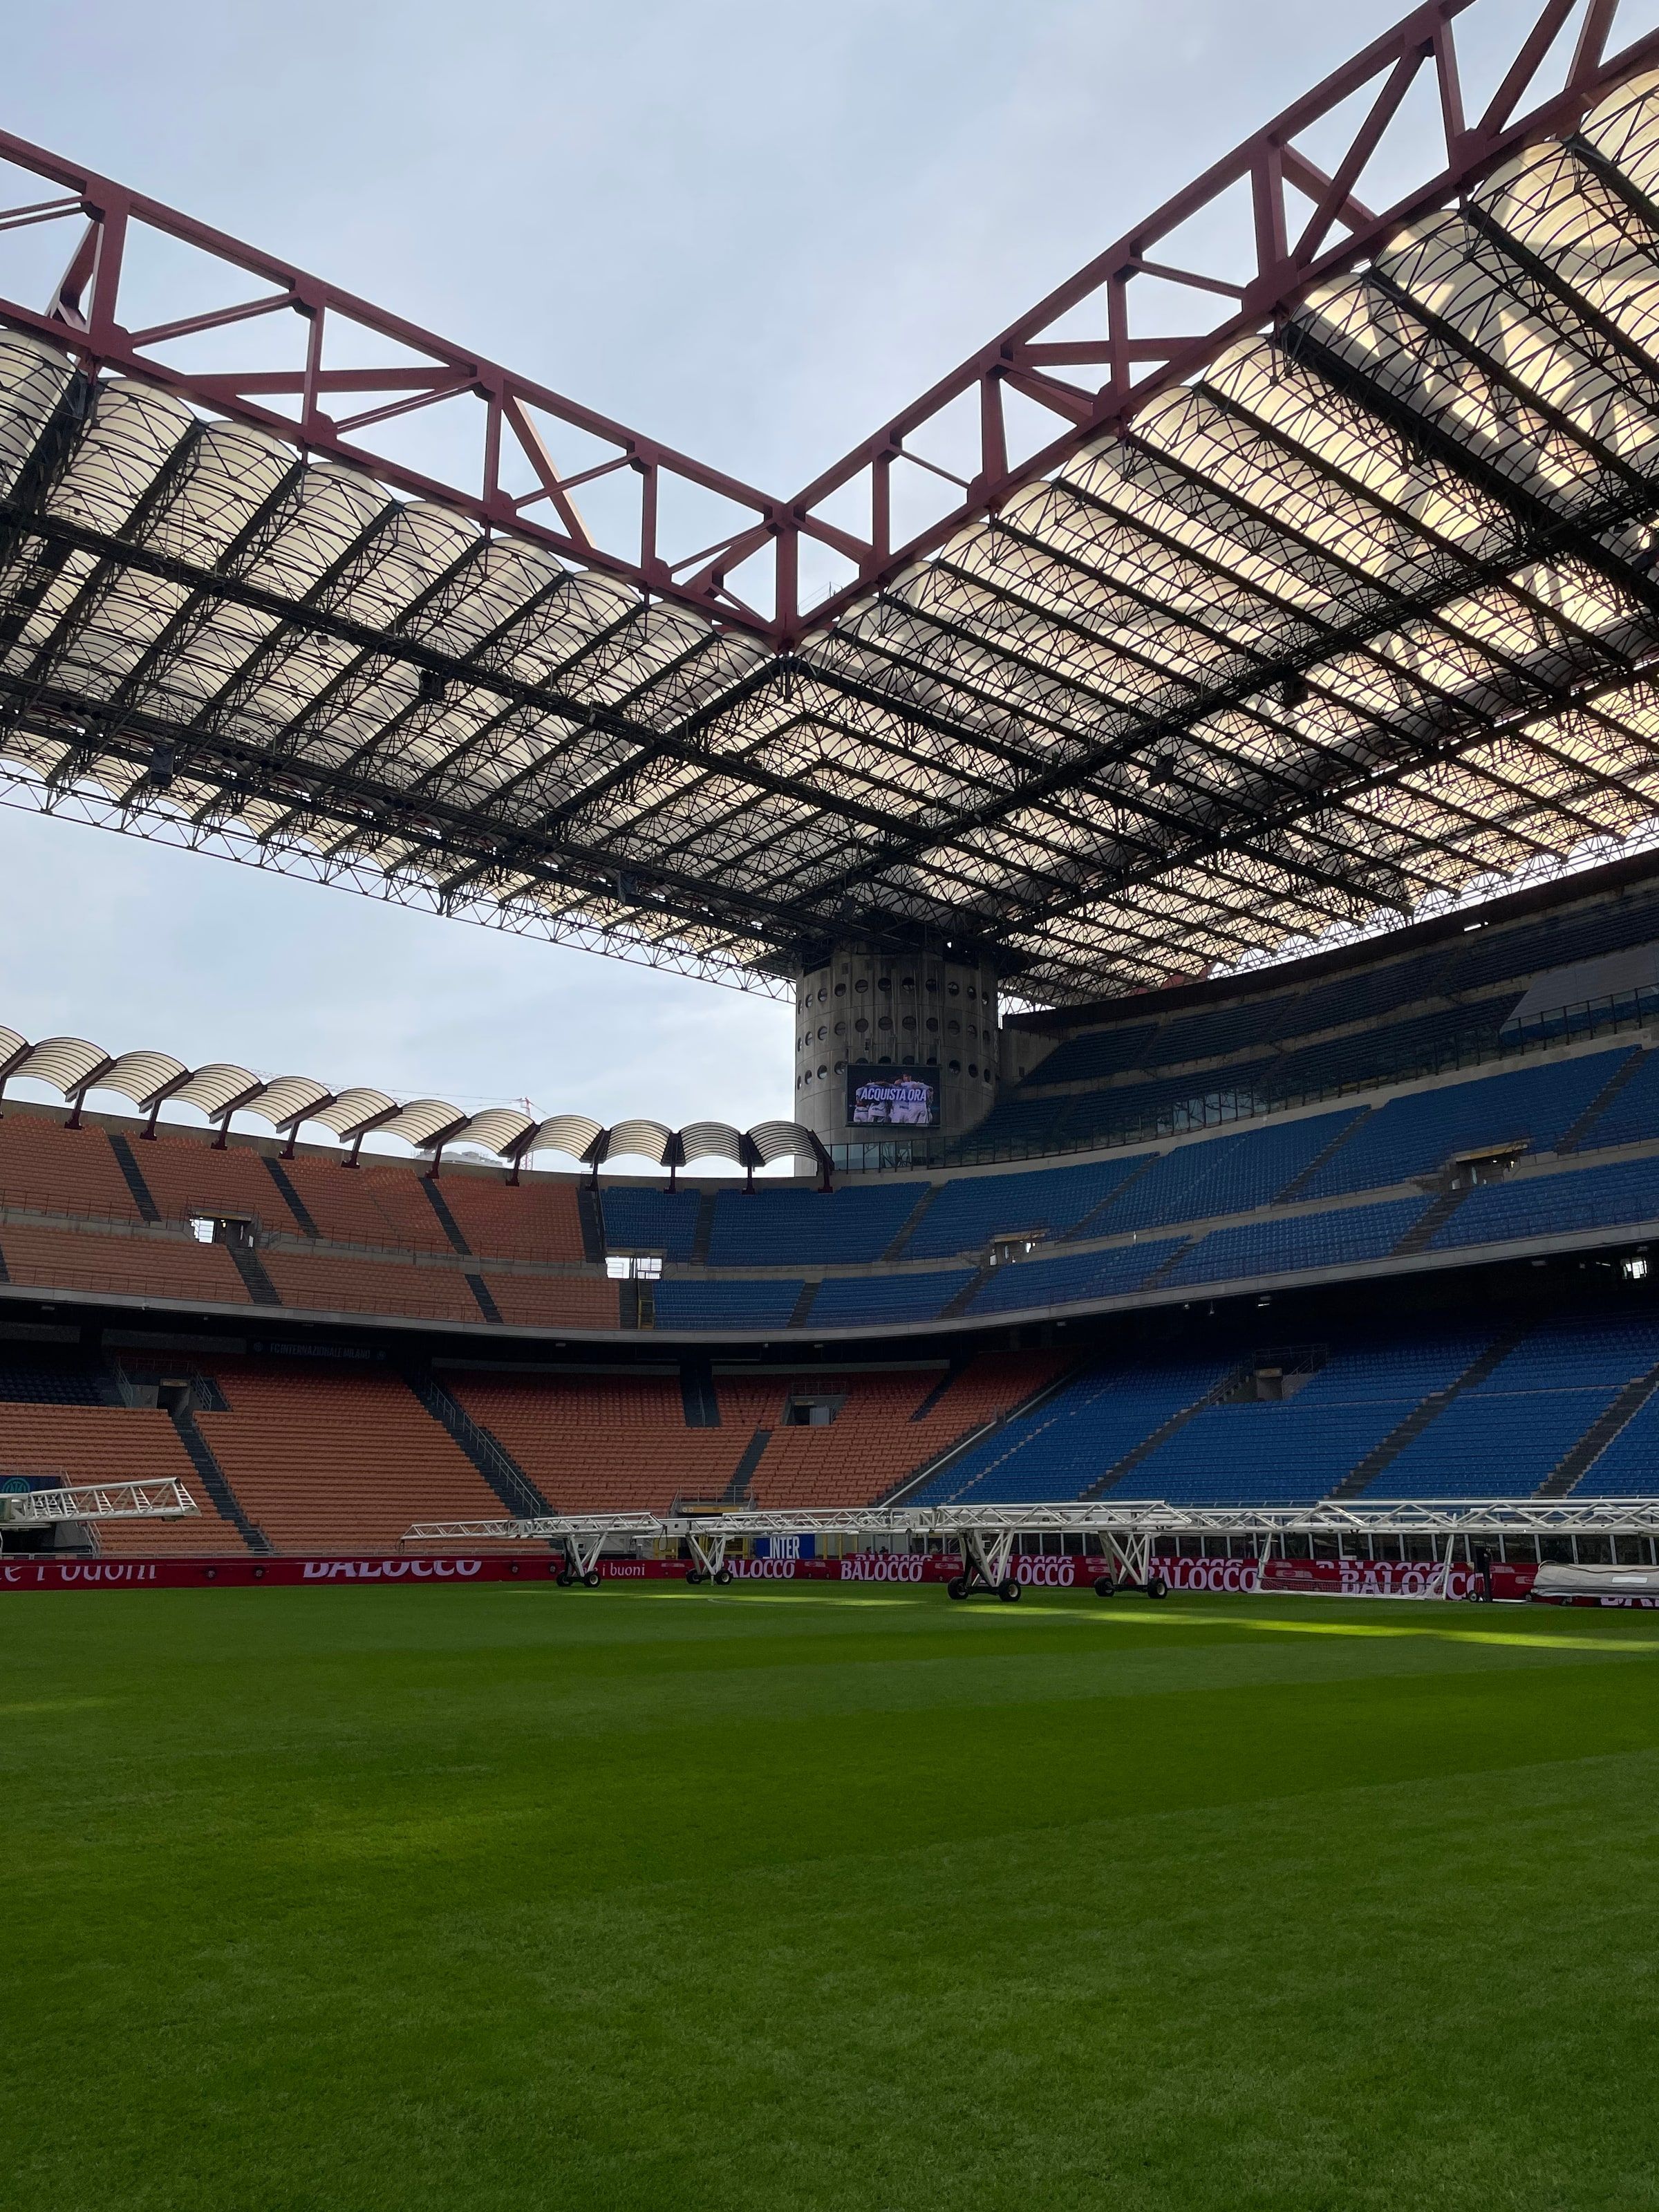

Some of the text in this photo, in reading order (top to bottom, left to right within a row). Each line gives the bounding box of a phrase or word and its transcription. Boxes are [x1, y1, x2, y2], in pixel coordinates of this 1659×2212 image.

[861, 1088, 926, 1101] ACQUISTA ORA
[270, 1342, 371, 1360] FC INTERNAZIONALE MILANO
[769, 1536, 800, 1559] INTER
[602, 1564, 606, 1576] i
[610, 1562, 646, 1576] buoni
[722, 1559, 795, 1579] ALOCCO
[841, 1560, 924, 1582] BALOCCO
